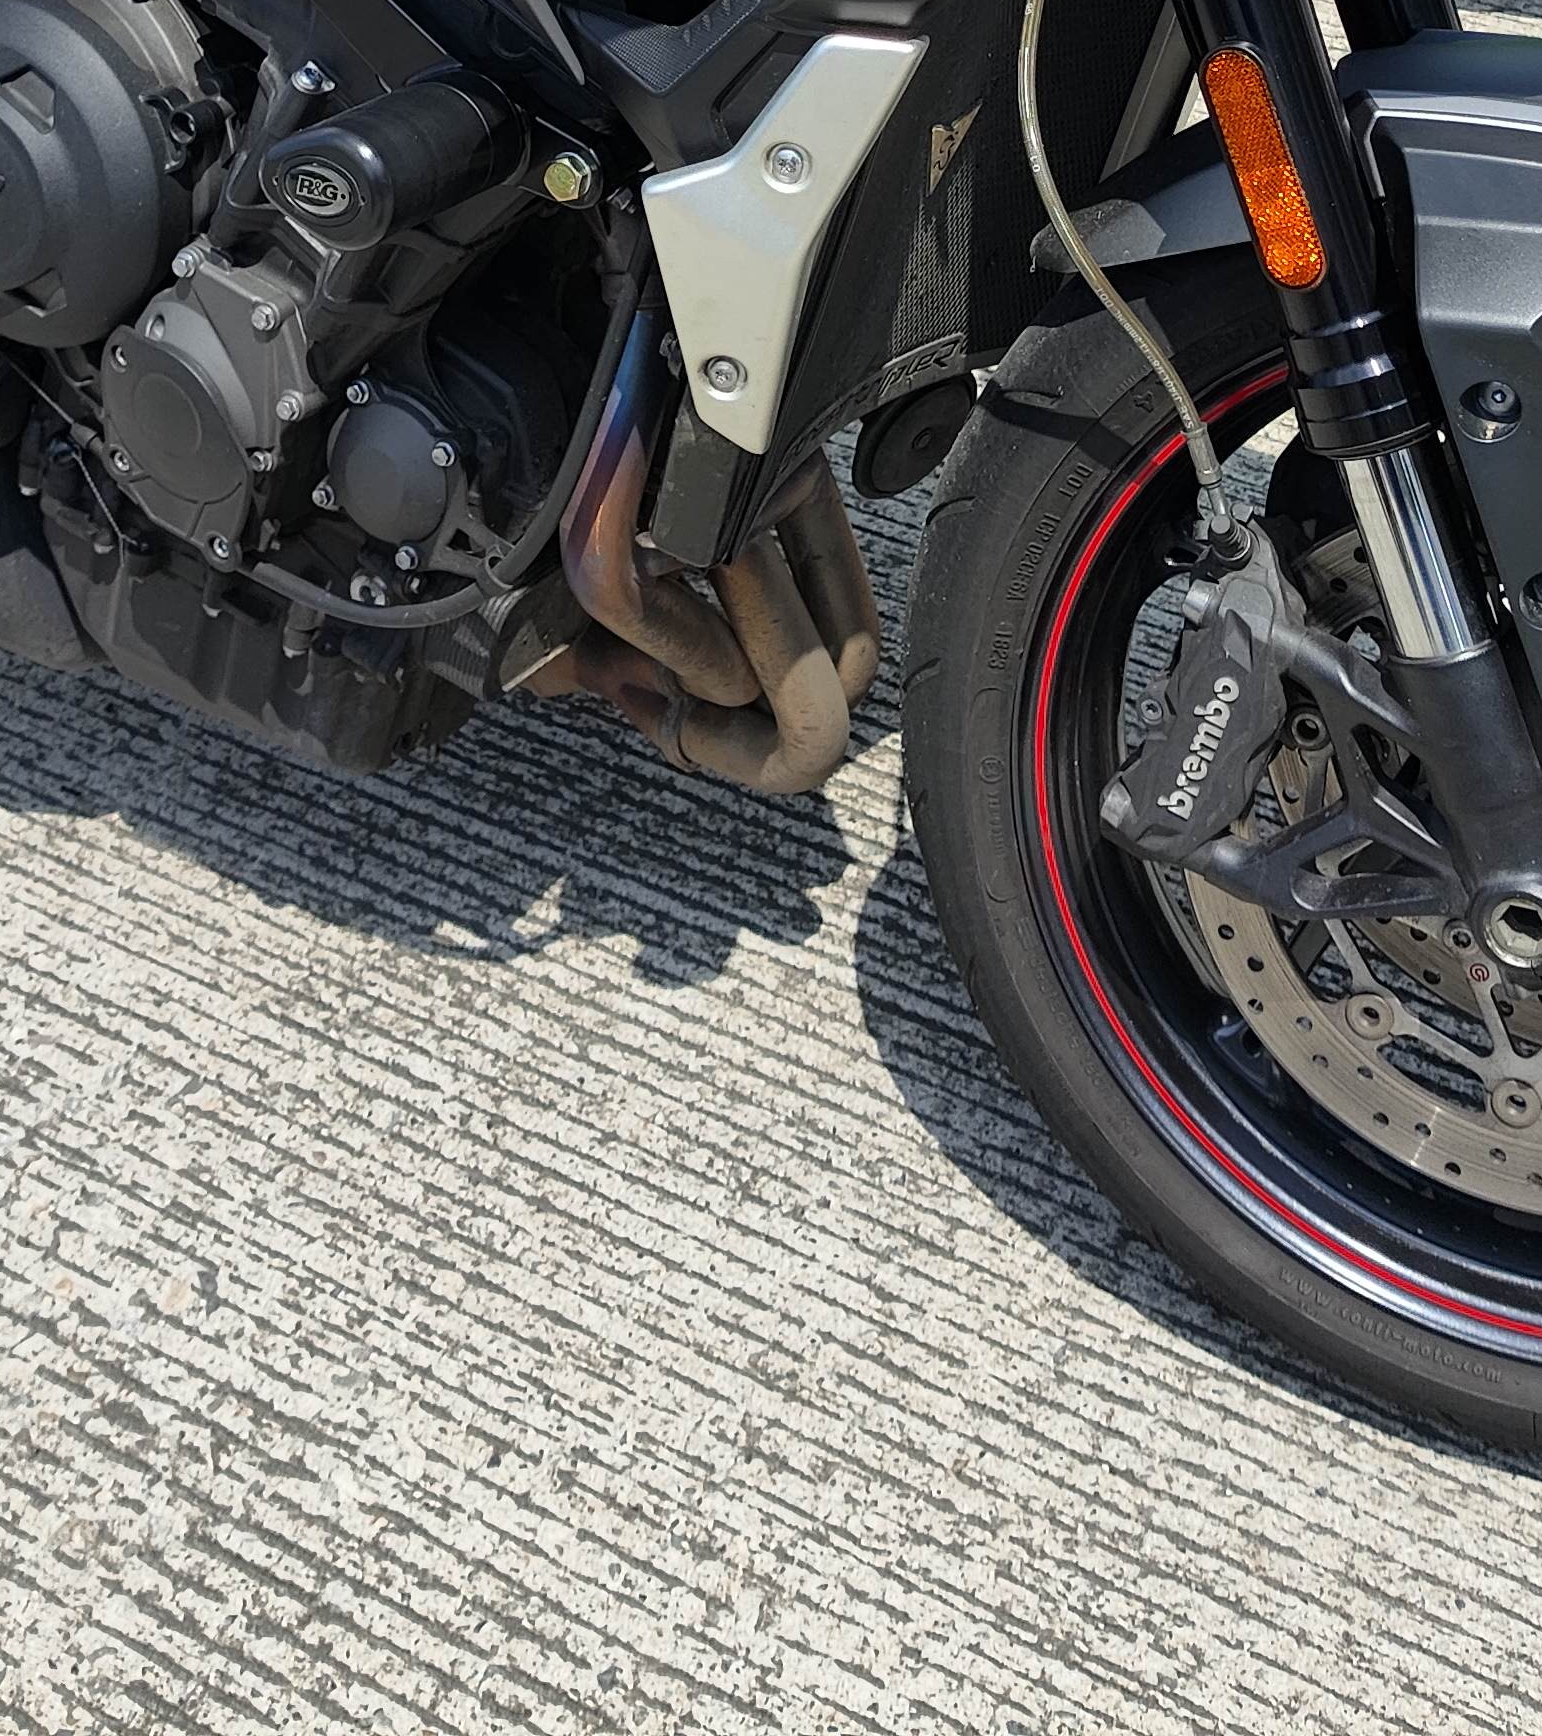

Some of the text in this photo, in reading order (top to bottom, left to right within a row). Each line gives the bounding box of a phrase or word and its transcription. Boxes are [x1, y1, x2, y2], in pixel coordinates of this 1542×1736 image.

[296, 174, 339, 202] R&G
[1058, 462, 1094, 501] DOT
[1156, 675, 1240, 821] brembo
